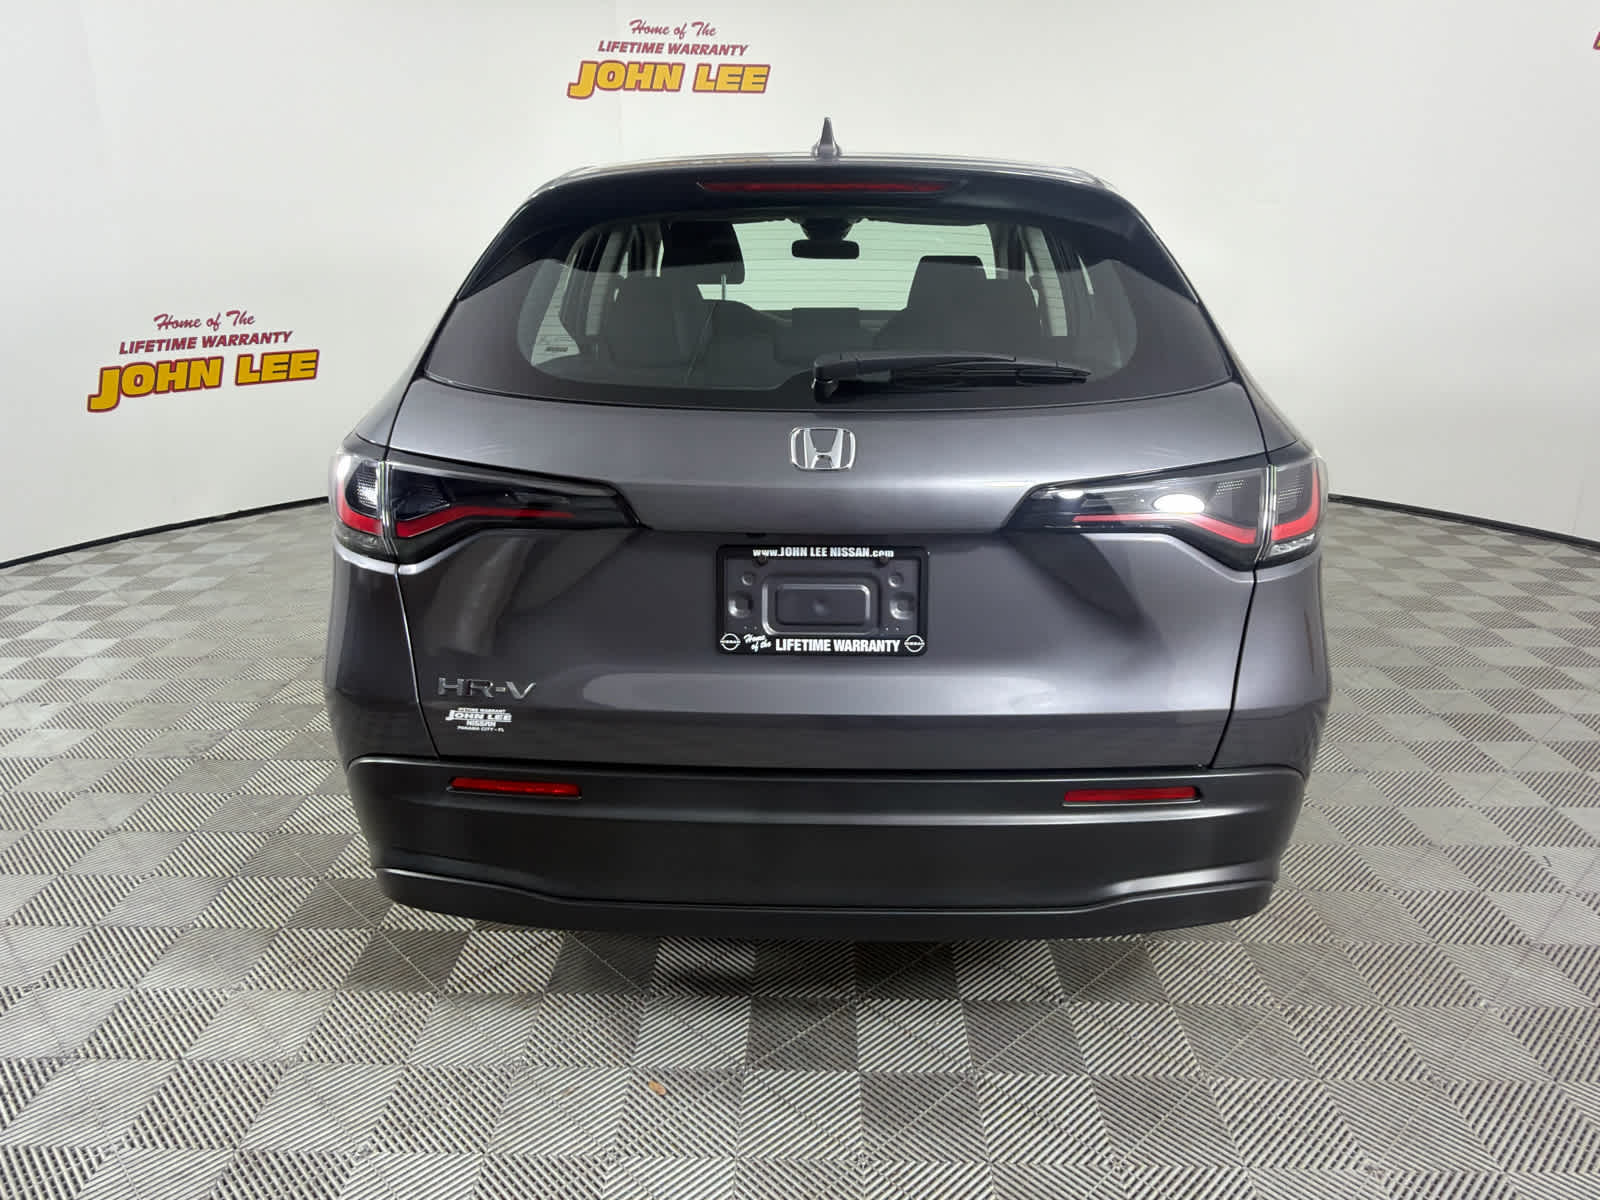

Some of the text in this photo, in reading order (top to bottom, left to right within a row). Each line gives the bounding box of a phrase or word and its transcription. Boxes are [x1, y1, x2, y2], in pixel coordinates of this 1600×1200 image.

[629, 19, 717, 40] Home of The
[598, 40, 749, 57] LIFETIME WARRANTY
[567, 60, 771, 99] JOHN LEE
[153, 310, 256, 331] Home of The
[119, 331, 293, 355] LIFETIME WARRANTY
[87, 349, 320, 413] JOHN LEE
[810, 547, 828, 558] LEE
[830, 547, 894, 558] NISSAN.com
[775, 639, 901, 653] LIFETIME WARRANTY
[437, 677, 537, 700] HR-V
[445, 709, 513, 723] JOHN LEE
